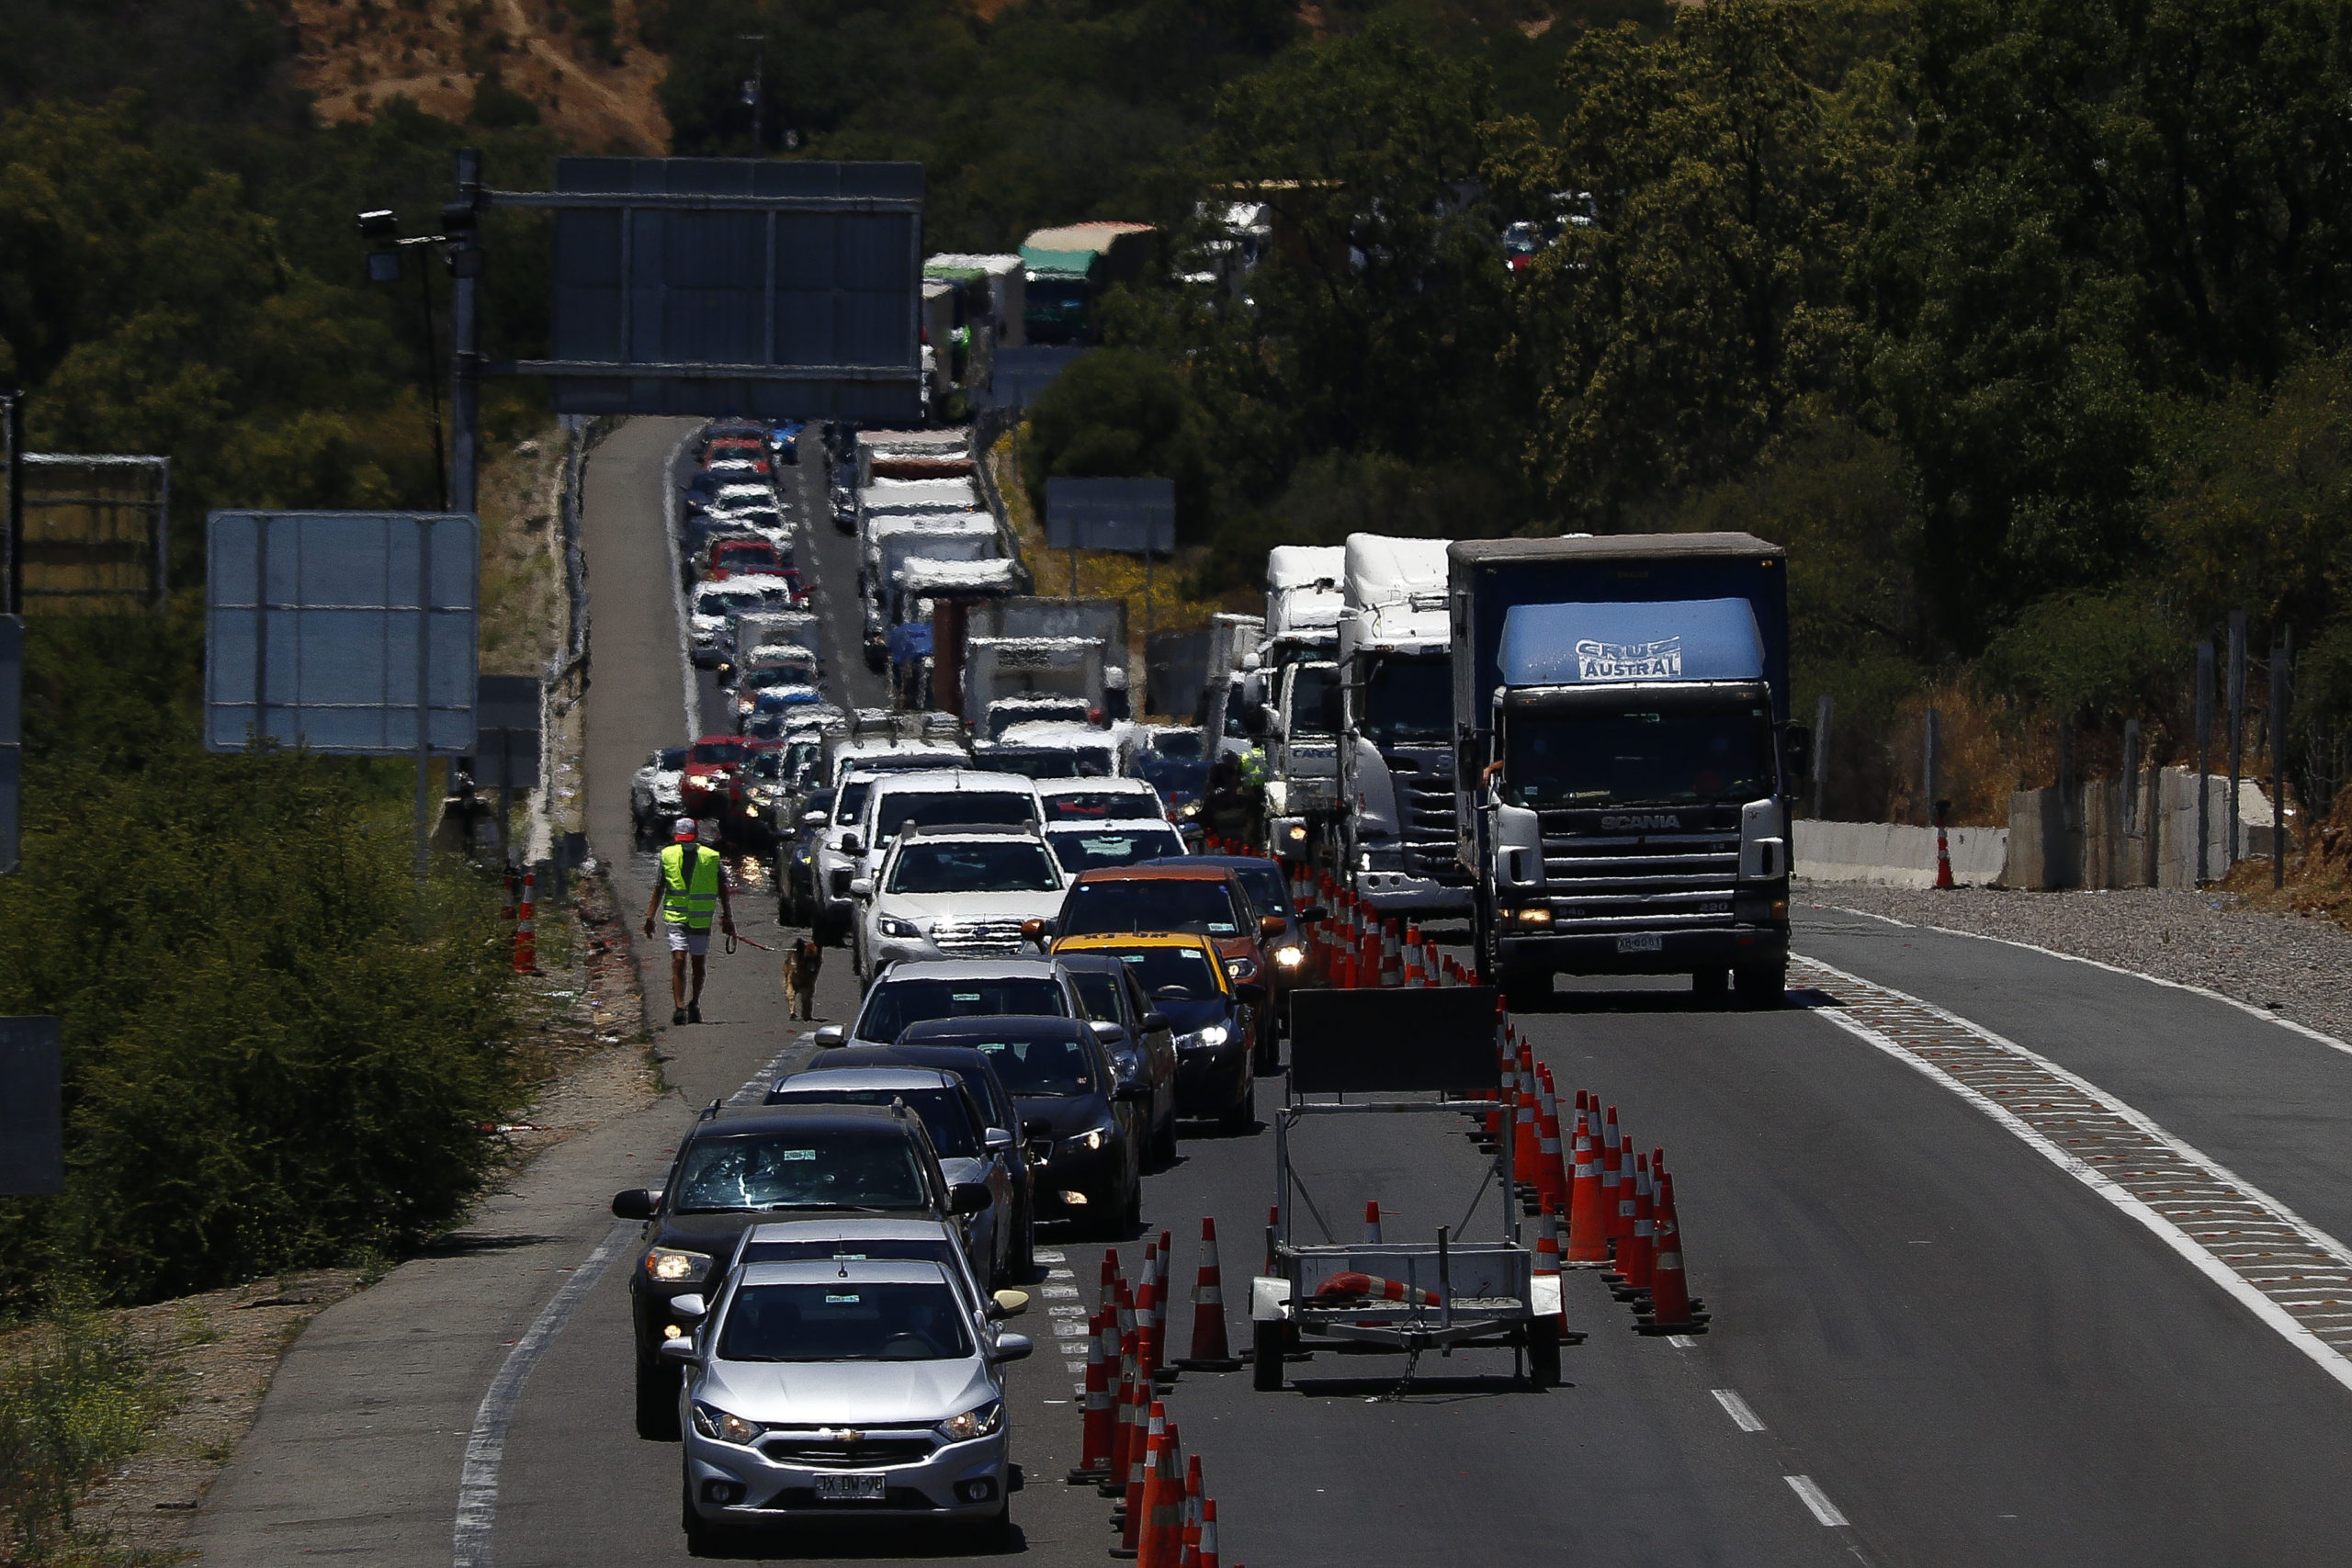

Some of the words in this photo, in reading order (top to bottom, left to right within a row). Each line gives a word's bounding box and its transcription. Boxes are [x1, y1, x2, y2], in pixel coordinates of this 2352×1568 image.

[1576, 636, 1680, 658] CRUZ
[1585, 656, 1679, 677] AUSTRAL
[1601, 815, 1680, 829] SCANIA
[1698, 902, 1729, 912] 220
